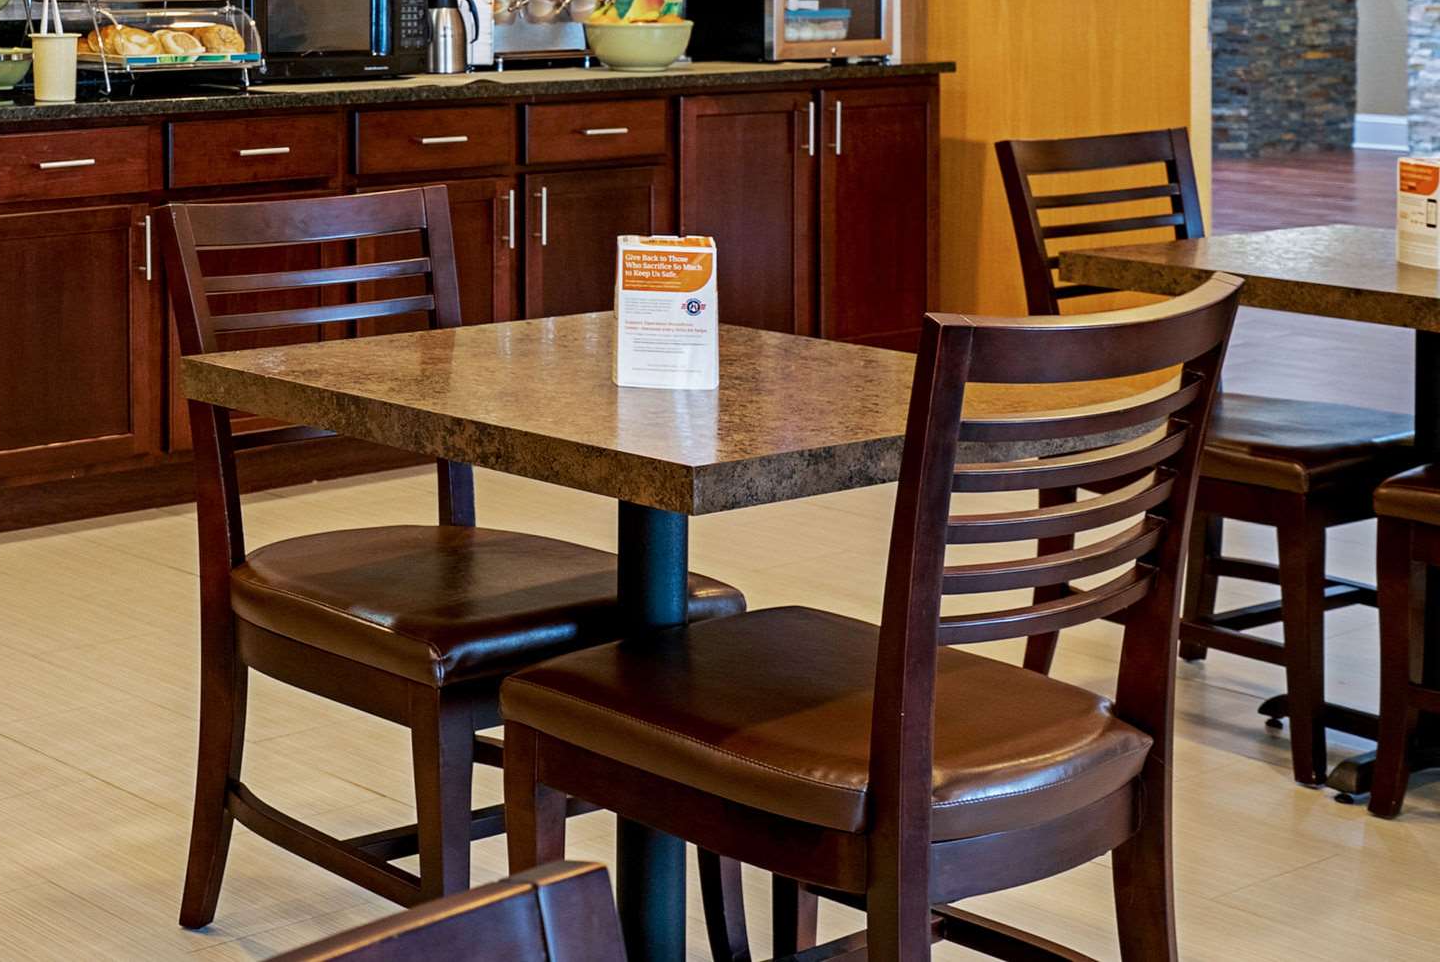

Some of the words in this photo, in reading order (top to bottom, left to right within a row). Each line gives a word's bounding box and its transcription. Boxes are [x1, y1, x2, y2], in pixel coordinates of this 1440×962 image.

[642, 254, 657, 262] Back
[643, 262, 672, 270] Sacrifice
[633, 270, 651, 279] Keep
